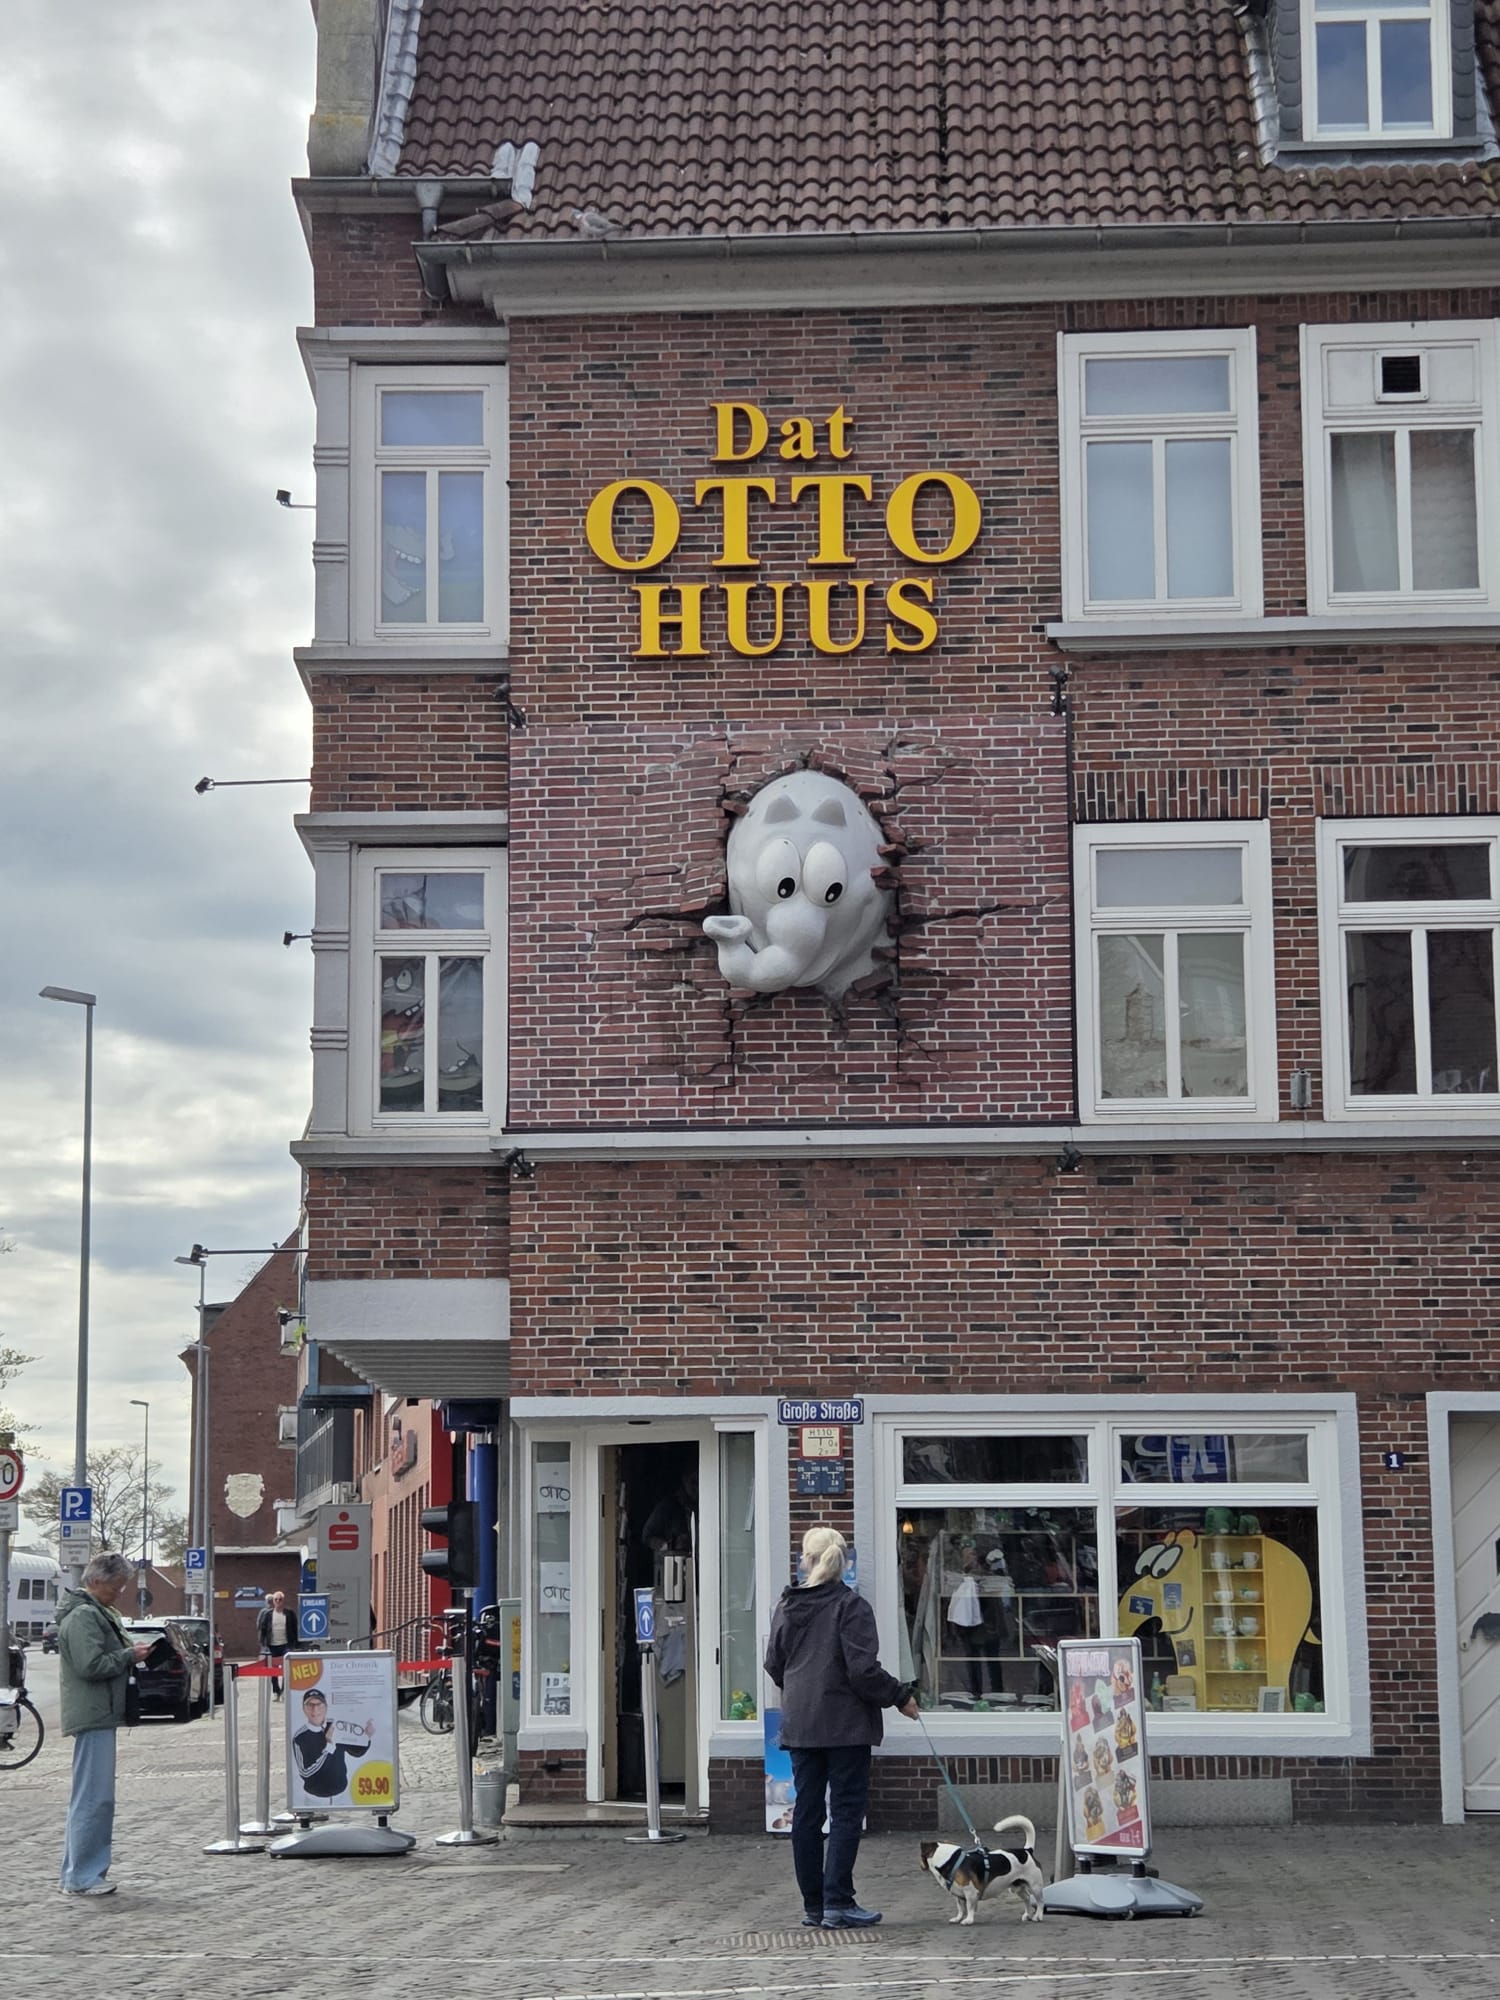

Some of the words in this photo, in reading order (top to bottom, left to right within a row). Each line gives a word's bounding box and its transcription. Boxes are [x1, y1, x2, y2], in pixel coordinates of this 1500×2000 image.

[709, 402, 854, 463] Dat
[585, 471, 982, 571] OTTO
[630, 577, 939, 657] HUUS
[782, 1402, 817, 1421] Große
[820, 1402, 859, 1421] Straße
[1389, 1454, 1399, 1468] 1
[540, 1486, 570, 1501] OTTO
[65, 1492, 83, 1518] P
[188, 1551, 200, 1567] P
[292, 1661, 319, 1680] NEU
[335, 1720, 365, 1736] OTTO
[358, 1776, 389, 1796] 59.90
